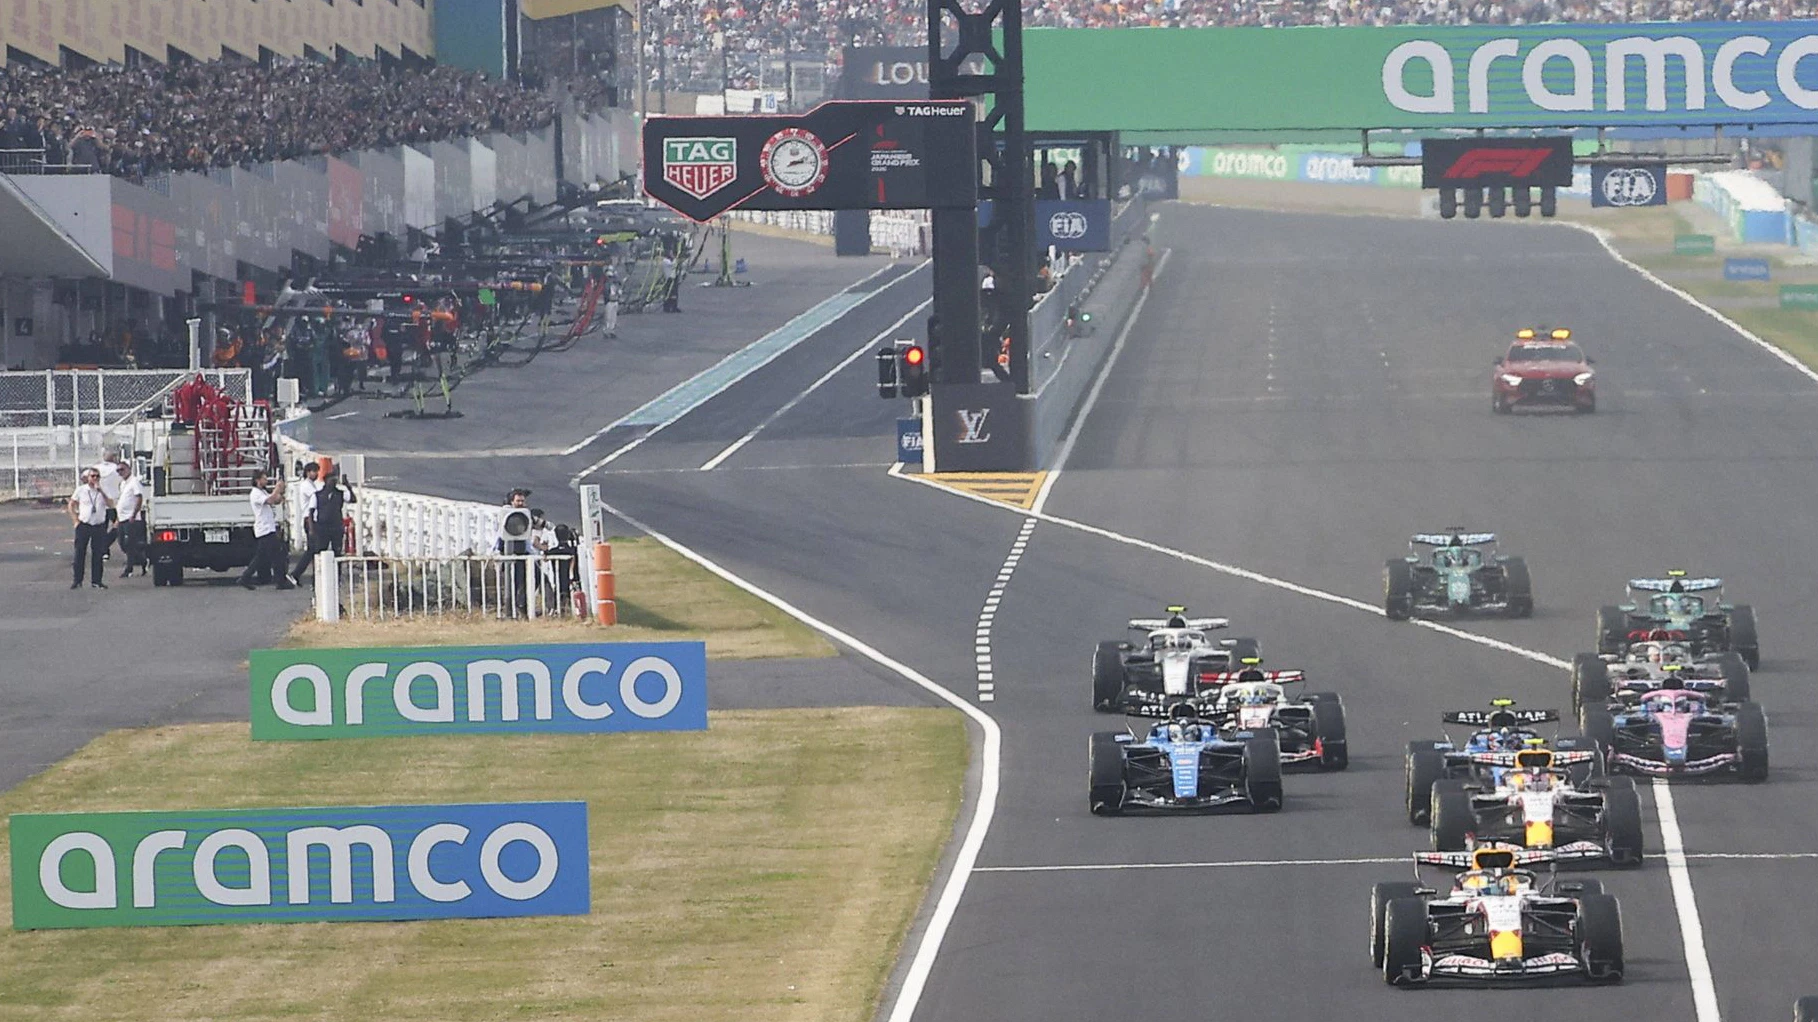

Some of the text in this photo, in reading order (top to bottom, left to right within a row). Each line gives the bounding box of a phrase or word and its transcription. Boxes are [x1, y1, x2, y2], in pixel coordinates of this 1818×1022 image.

[878, 62, 929, 85] LOU
[669, 142, 729, 161] TAG
[669, 166, 732, 194] HEUER
[1607, 176, 1653, 195] FIA
[1052, 218, 1084, 234] FIA
[271, 656, 682, 726] aramco
[38, 822, 559, 910] aramco
